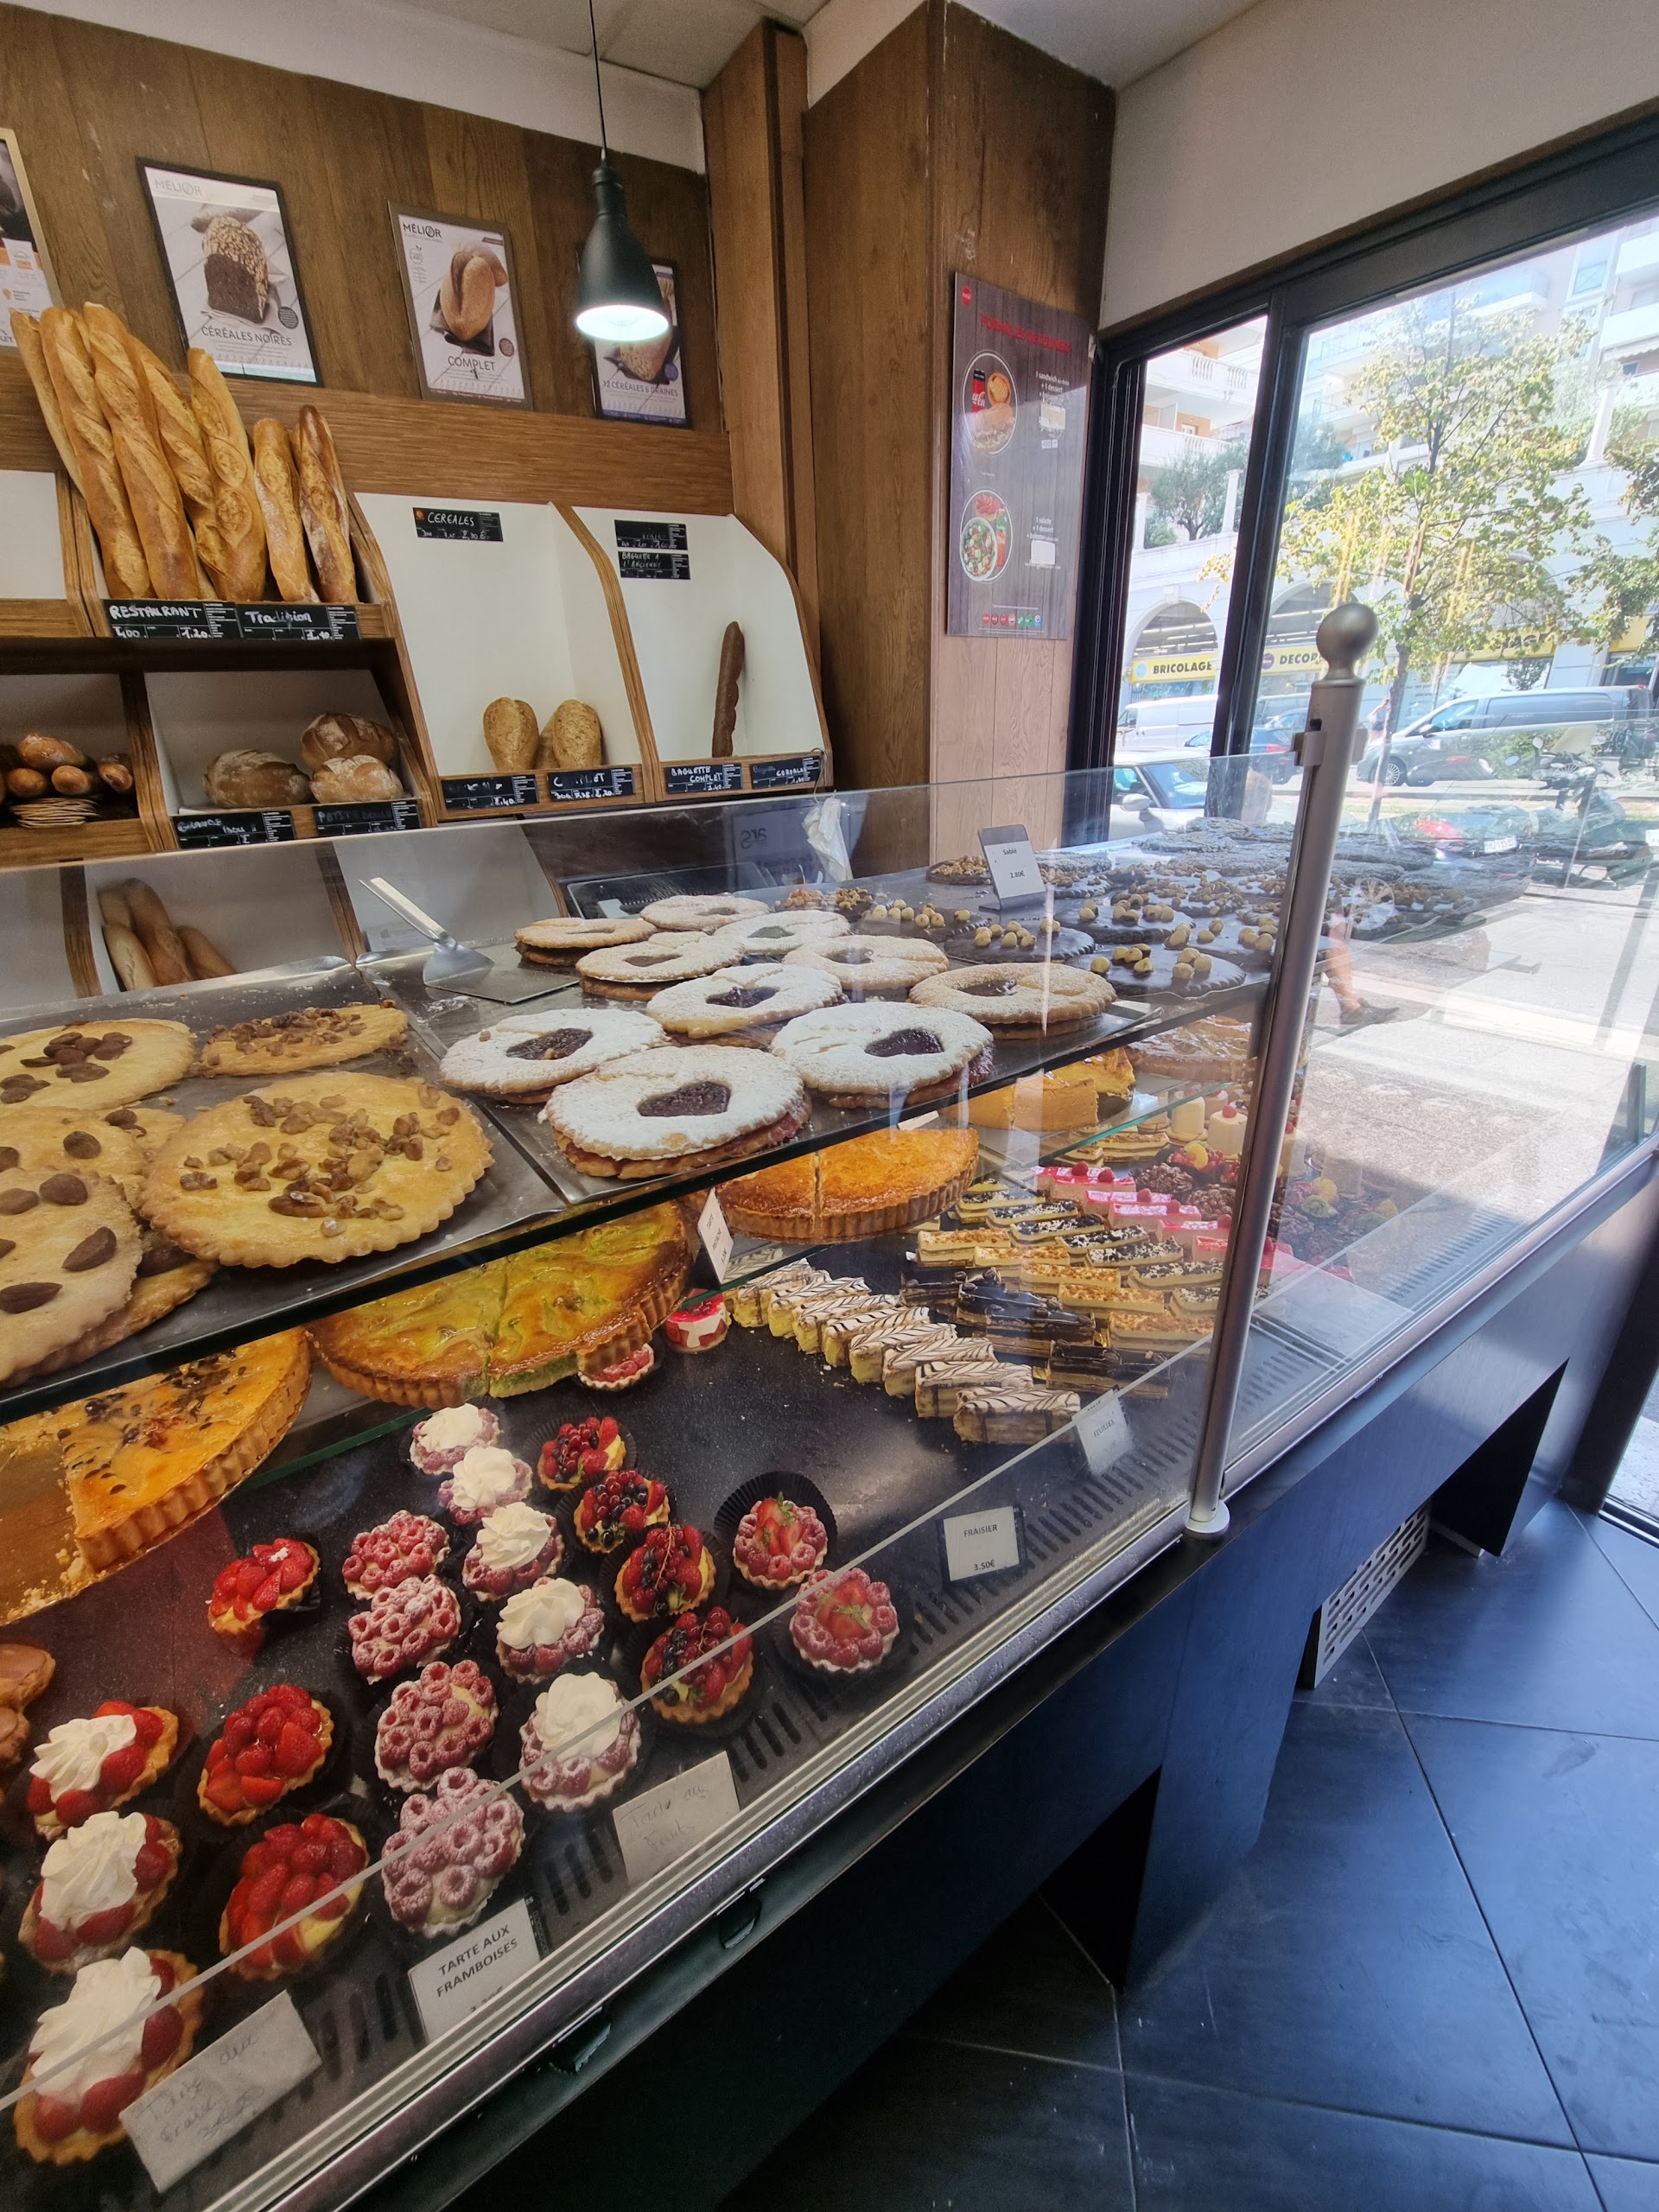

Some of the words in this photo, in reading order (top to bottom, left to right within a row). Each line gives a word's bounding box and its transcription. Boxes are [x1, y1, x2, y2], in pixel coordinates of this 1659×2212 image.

[201, 325, 253, 341] CÉRÉALES
[255, 333, 292, 346] NOIRES
[448, 355, 495, 372] COMPLET
[427, 512, 474, 527] CEREALES
[109, 605, 202, 620] RESTAURANT
[245, 610, 312, 624] Tradition
[1153, 661, 1212, 674] BRICOLAGE
[671, 766, 711, 776] BAGUETTE
[690, 772, 722, 783] COMPLET
[963, 1523, 998, 1538] FRAISIER
[973, 1559, 996, 1572] 3.50€
[438, 1943, 481, 1976] TARTE
[482, 1923, 511, 1950] AUX
[436, 1937, 518, 1999] FRAMBOISES
